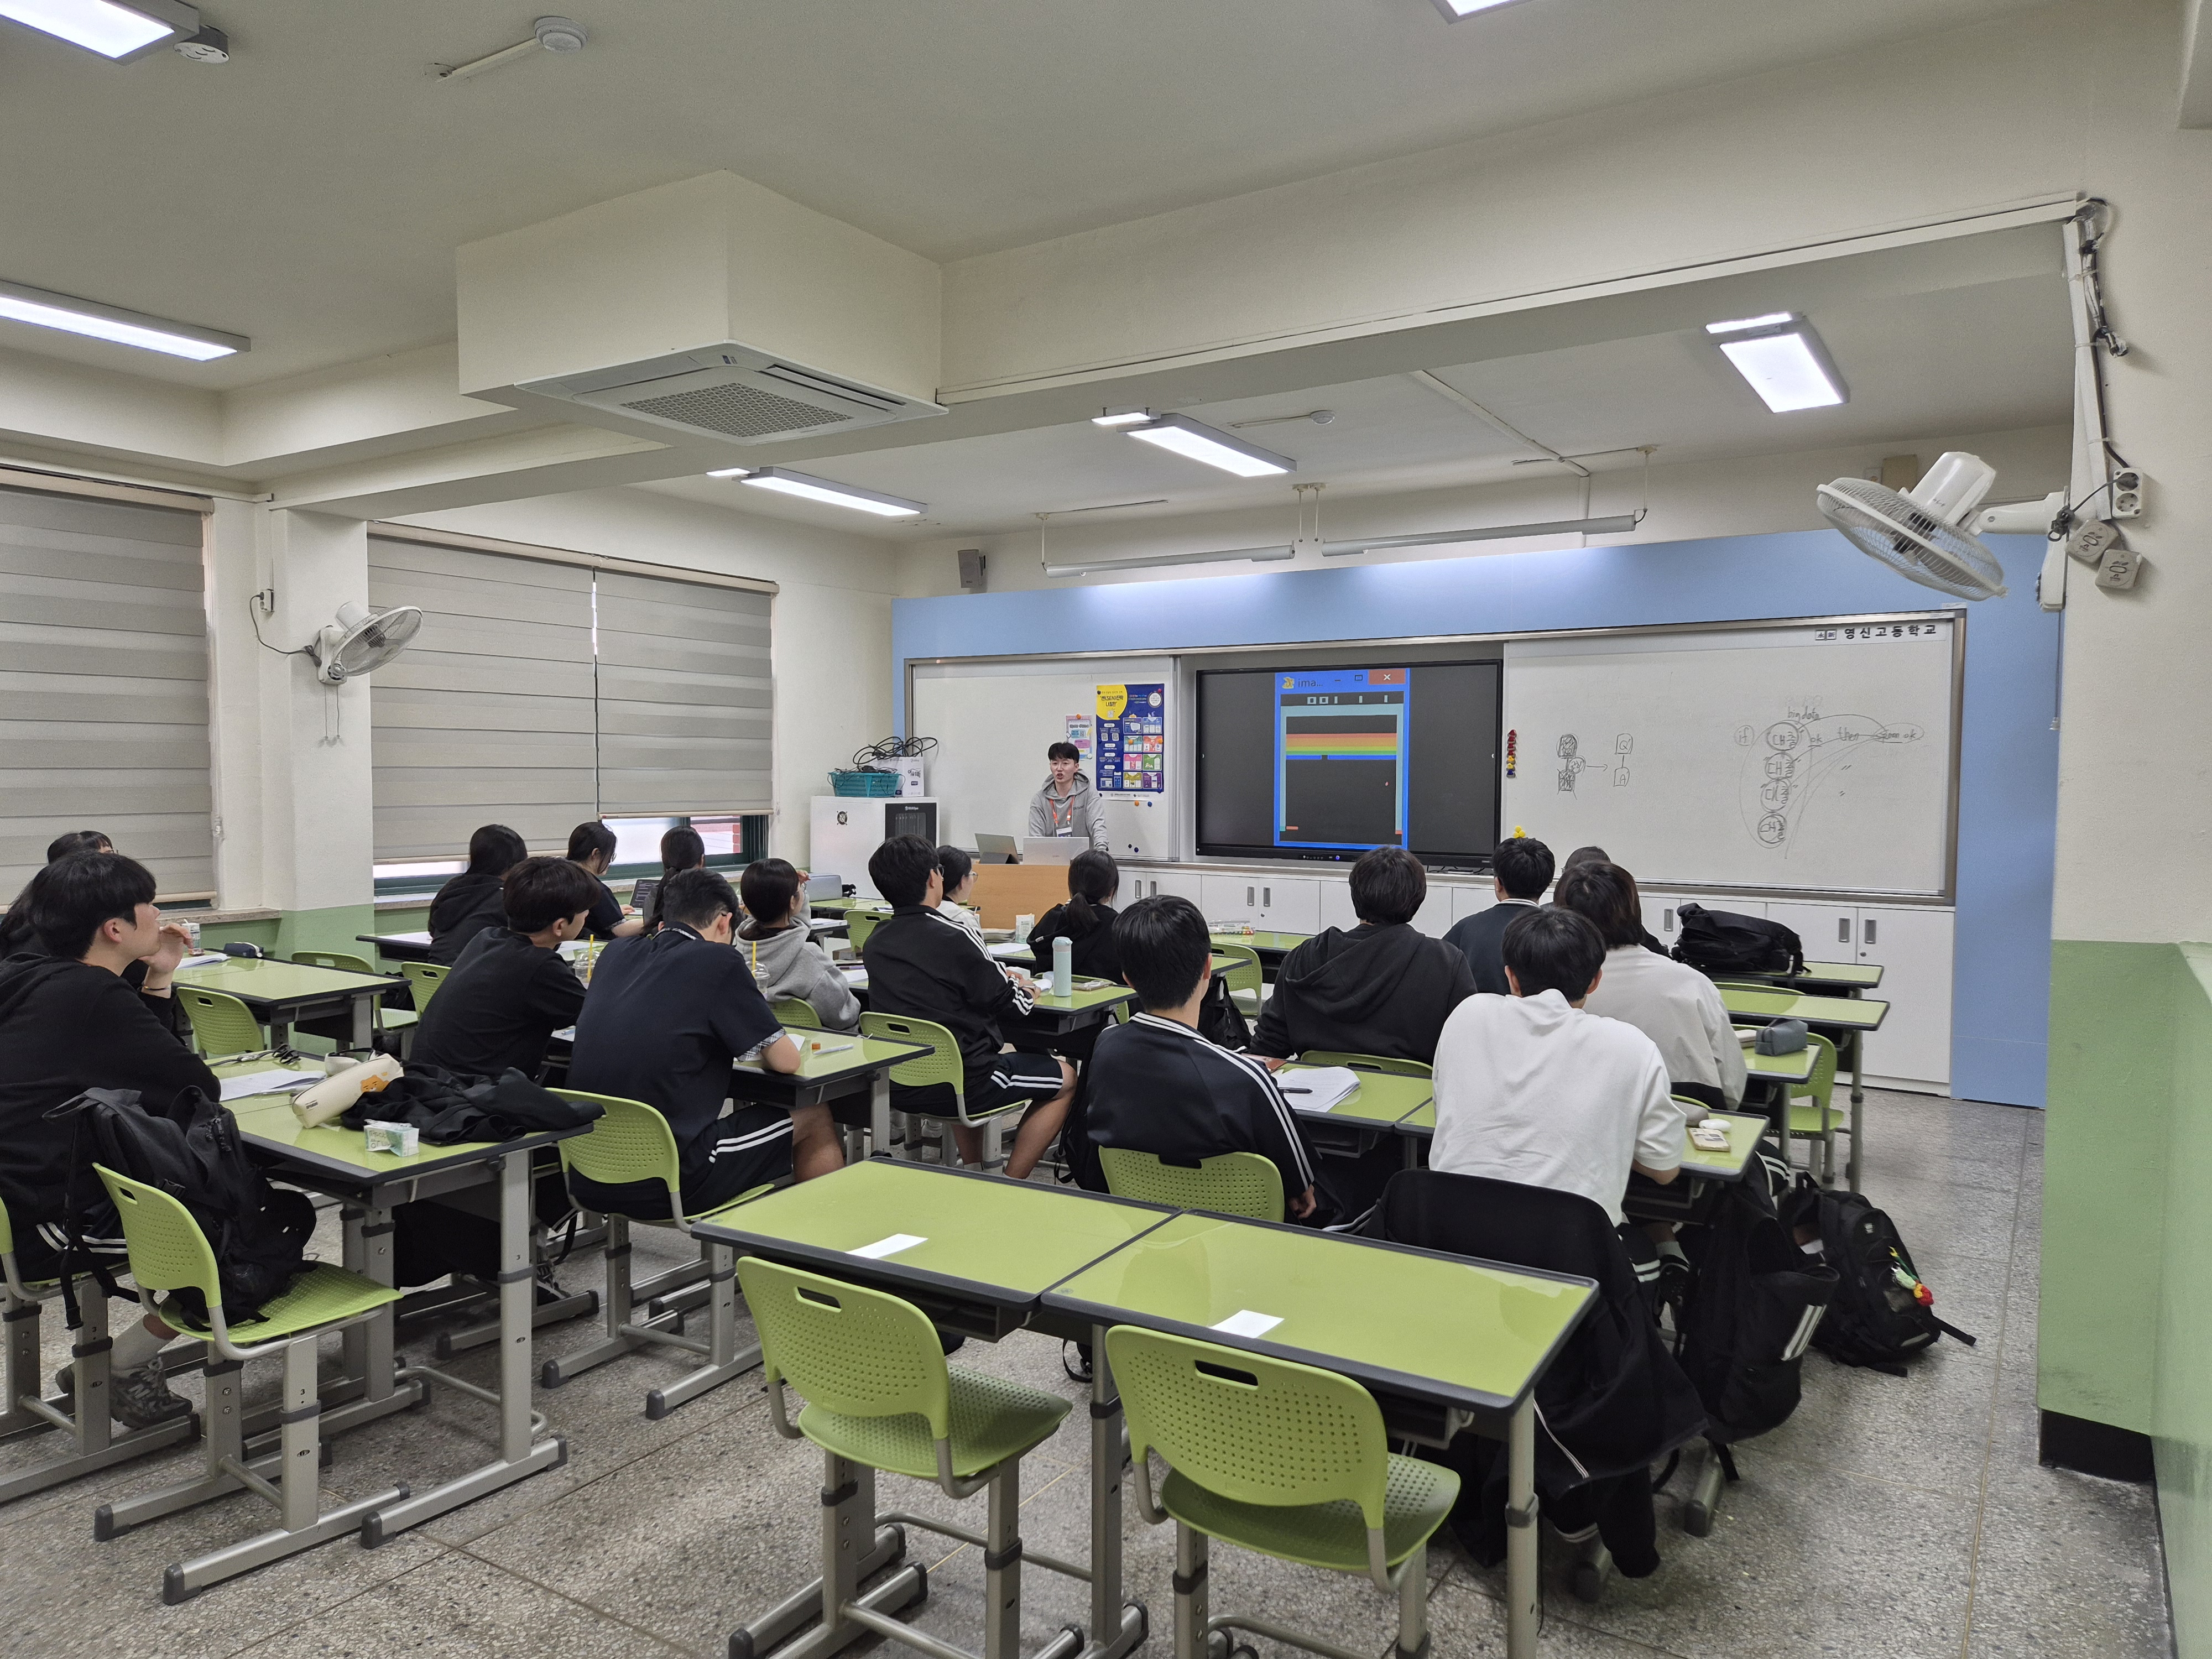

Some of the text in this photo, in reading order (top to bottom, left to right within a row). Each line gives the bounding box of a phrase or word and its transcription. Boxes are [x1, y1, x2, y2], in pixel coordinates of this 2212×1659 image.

[1844, 625, 1936, 640] 영신고등학교
[1811, 734, 1823, 744] ok
[1904, 729, 1916, 740] ok
